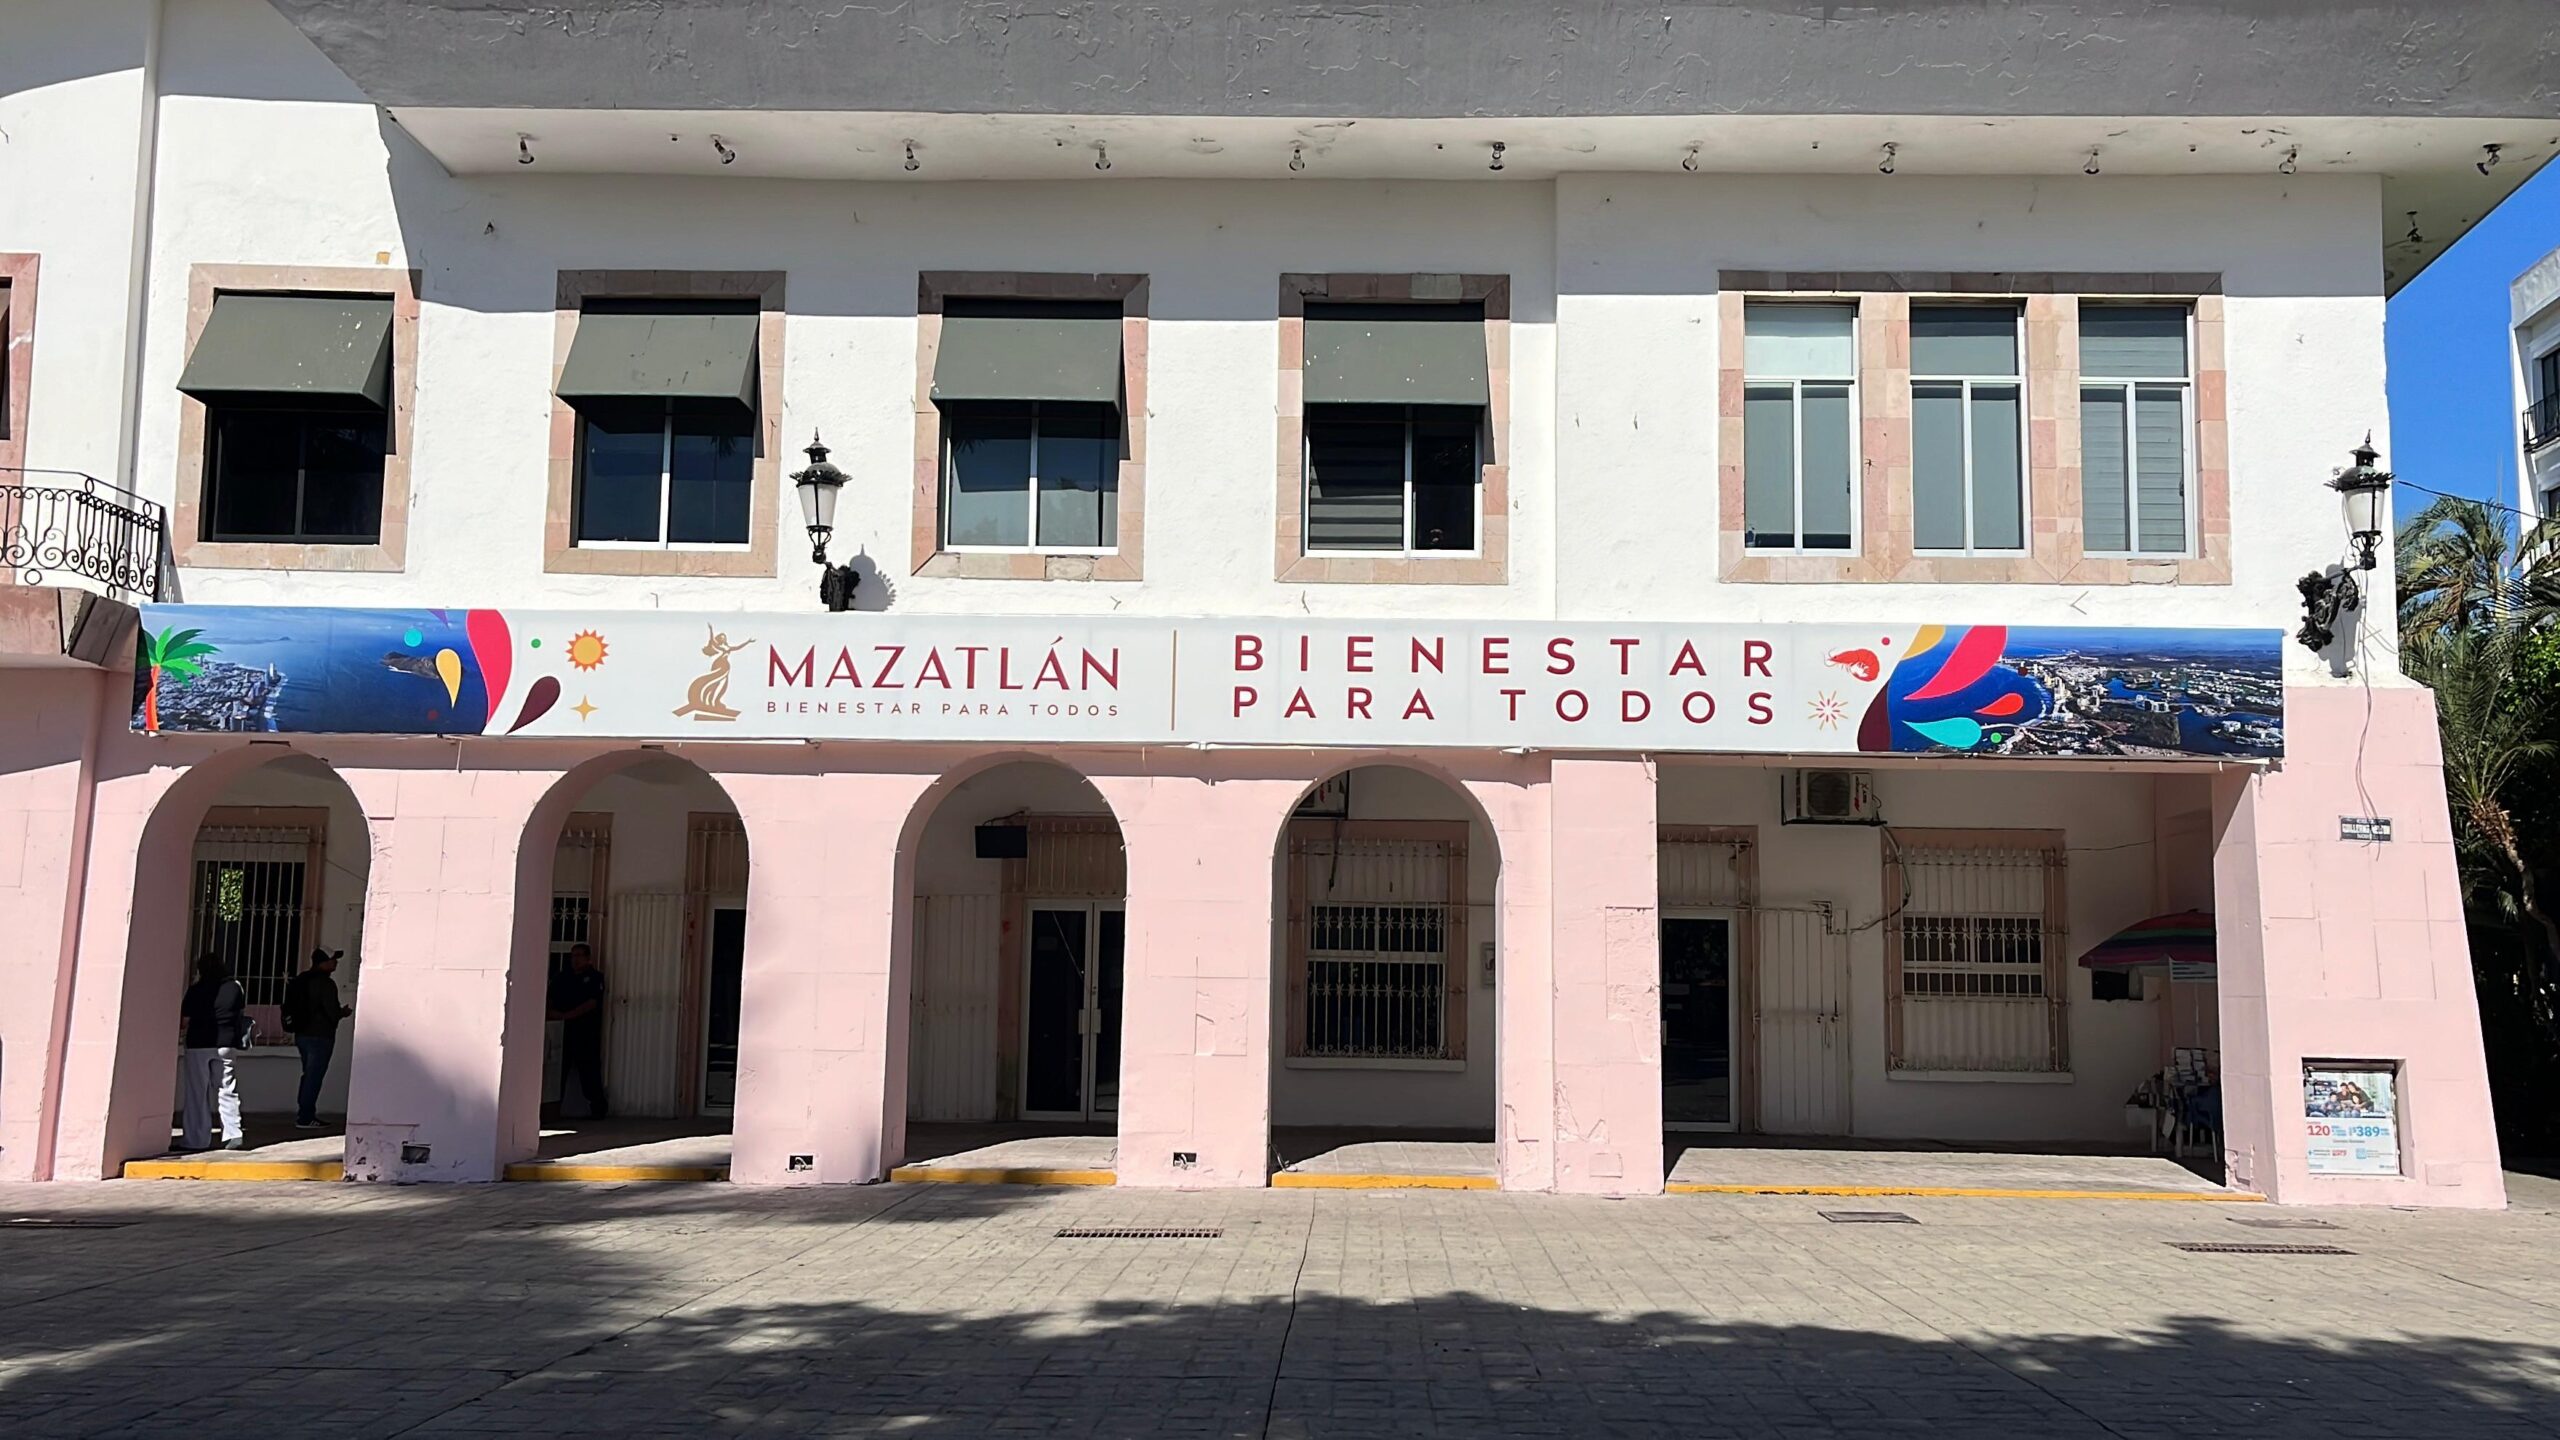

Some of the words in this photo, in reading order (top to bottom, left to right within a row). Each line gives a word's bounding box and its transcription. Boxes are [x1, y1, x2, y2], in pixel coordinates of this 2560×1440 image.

[767, 635, 1119, 691] MAZATLÁN
[1233, 634, 1773, 678] BIENESTAR
[767, 701, 922, 715] BIENESTAR
[942, 703, 1009, 716] PARA
[1030, 704, 1119, 717] TODOS
[1233, 685, 1435, 720] PARA
[1500, 689, 1774, 726] TODOS
[2307, 1125, 2331, 1136] 120
